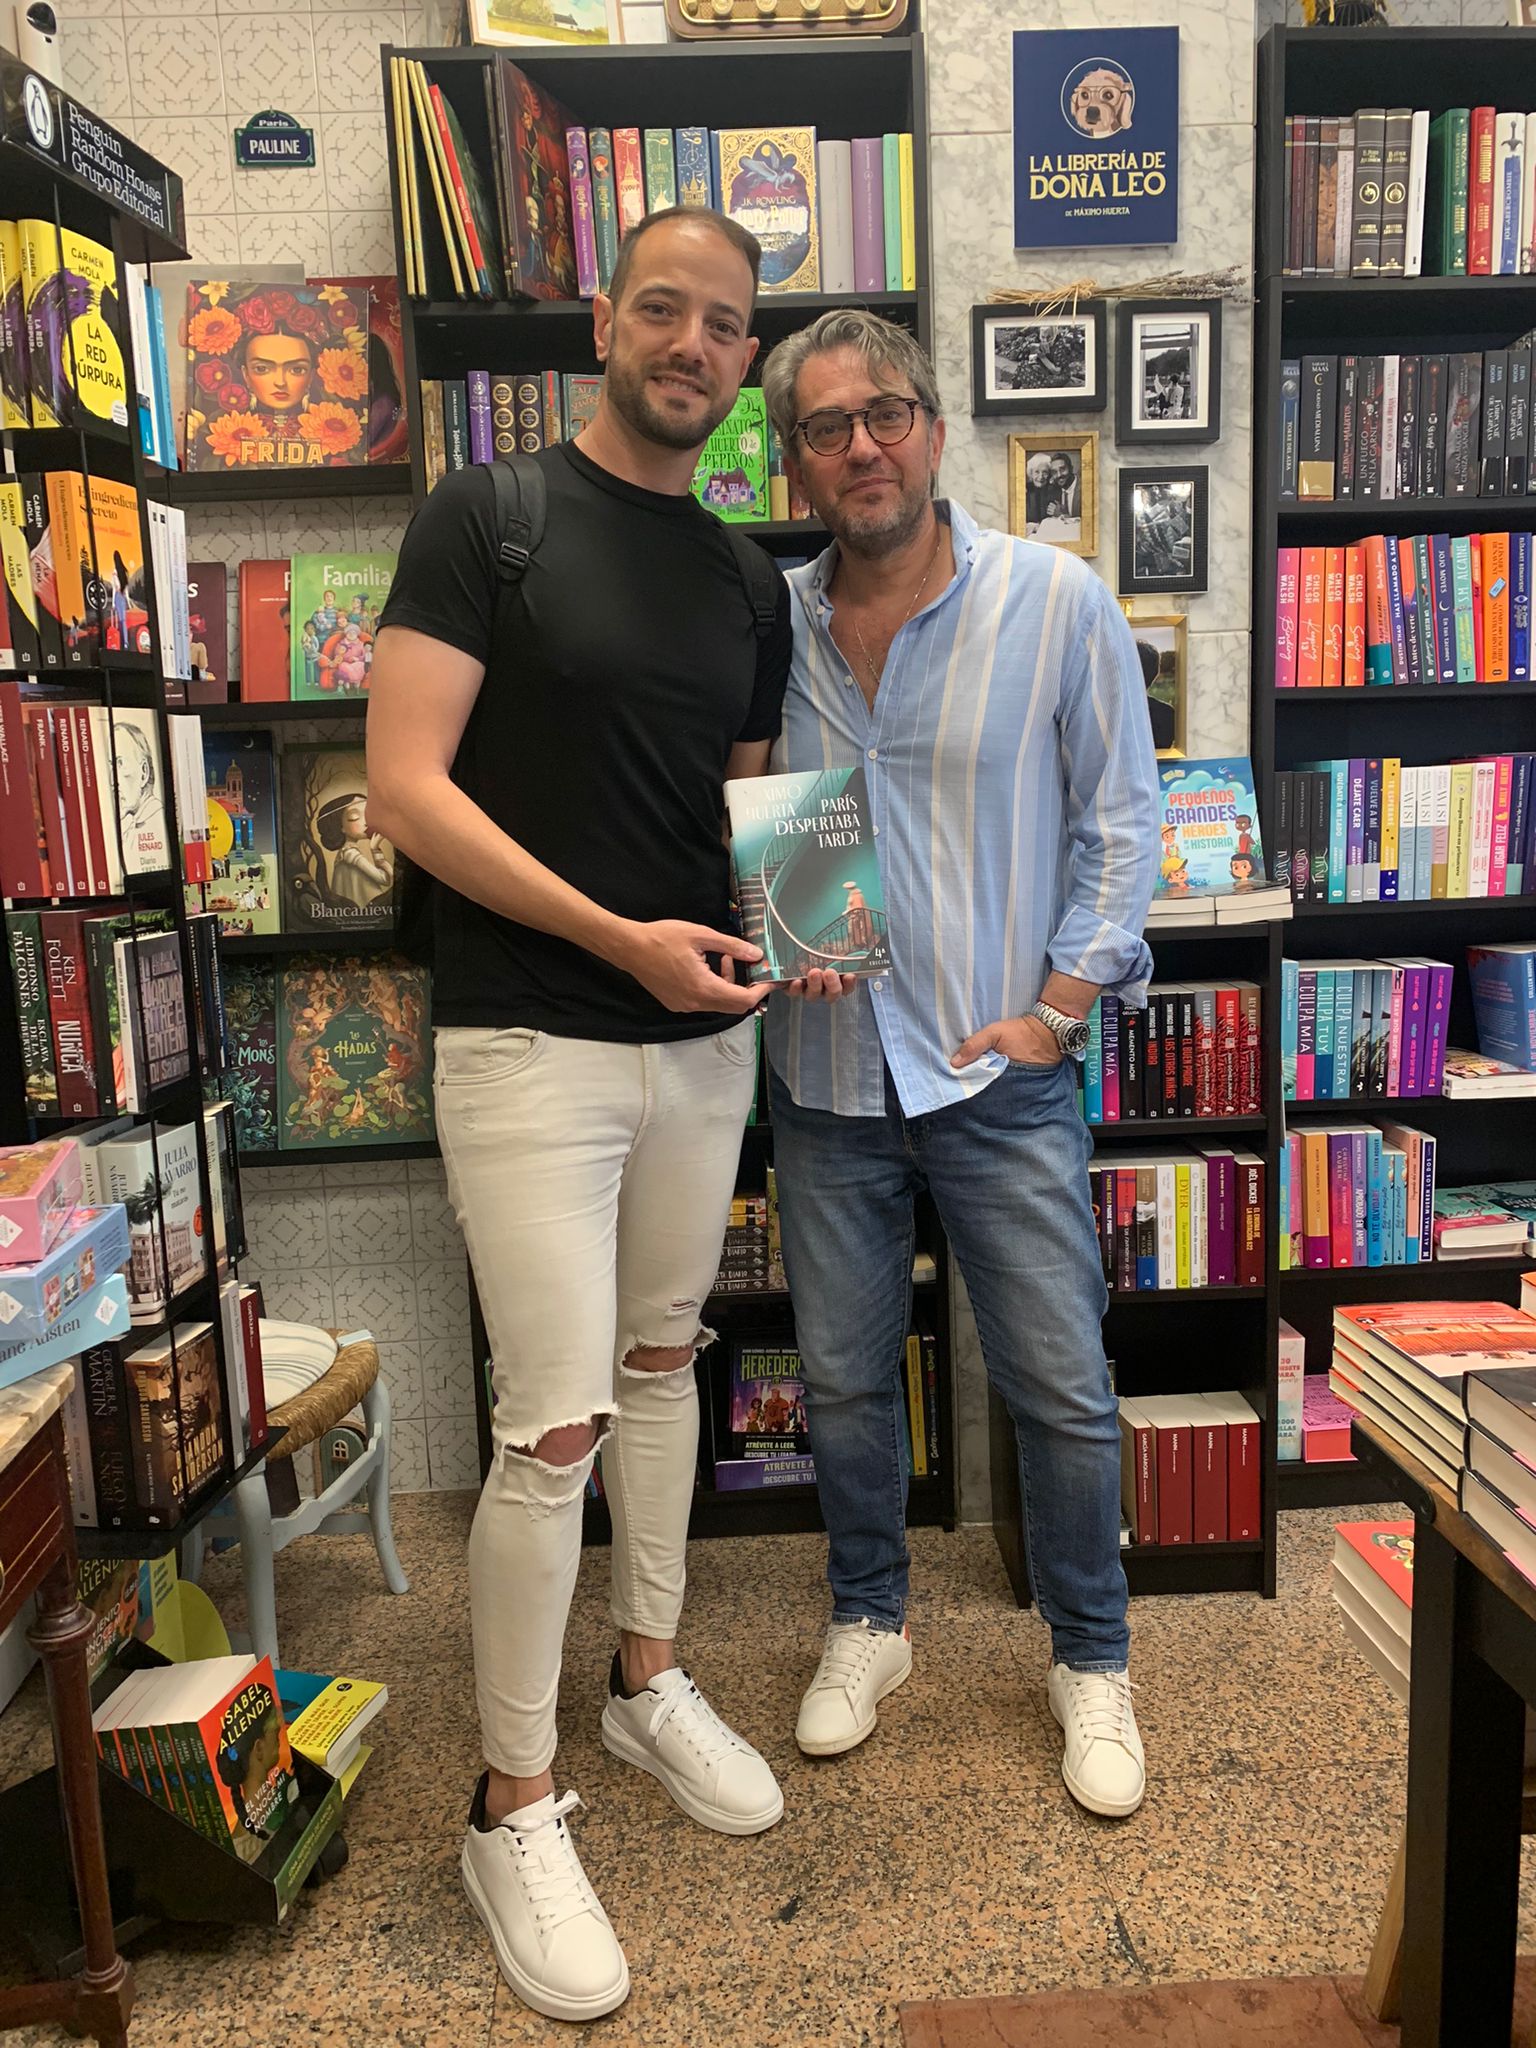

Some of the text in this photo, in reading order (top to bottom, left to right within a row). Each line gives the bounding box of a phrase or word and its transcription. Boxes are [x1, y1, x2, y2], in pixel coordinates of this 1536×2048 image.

[67, 101, 123, 158] Penguin
[259, 119, 289, 127] Paris
[249, 139, 301, 154] PAULINE
[1030, 150, 1166, 172] LA LIBRERÍA DE
[71, 126, 161, 205] Random House
[72, 152, 164, 228] Grupo Editorial
[1030, 171, 1166, 199] DOÑA LEO
[1505, 171, 1513, 225] ABERCROMBIE
[1074, 207, 1102, 217] MÁXIMO
[1103, 207, 1130, 215] HUERTA
[71, 248, 104, 269] CARMEN
[78, 265, 100, 280] MOLA
[87, 323, 102, 341] LA
[86, 344, 107, 364] RED
[78, 358, 123, 391] ÚRPURA
[241, 442, 324, 463] FRIDA
[704, 453, 754, 468] PEPINOS
[1360, 431, 1369, 479] UN FUEGO
[1369, 426, 1377, 484] EN LA CARNE
[7, 493, 16, 526] CARMEN
[33, 494, 41, 528] CARMEN
[8, 556, 17, 587] MADRES
[15, 564, 23, 578] LAS
[324, 564, 391, 587] Familia
[1392, 564, 1400, 601] LLAMADO
[1280, 575, 1288, 604] WALSH
[1279, 616, 1294, 661] Binding
[1410, 634, 1417, 643] de
[36, 718, 46, 747] FRANK
[59, 718, 69, 753] RENARD
[79, 718, 89, 753] RENARD
[1169, 788, 1235, 807] PEQUEÑOS
[1370, 779, 1378, 806] VUELVE
[1499, 763, 1509, 808] EMILY HENRY
[821, 794, 858, 813] PARÍS
[1165, 805, 1237, 824] GRANDES
[1353, 778, 1361, 828] DÉJATE CAER
[775, 813, 861, 836] DESPERTABA
[1369, 815, 1378, 828] MÍ
[138, 833, 155, 842] JULES
[138, 841, 162, 852] RENARD
[816, 830, 862, 849] TARDE
[1190, 837, 1233, 849] HISTORIA
[1494, 824, 1507, 869] LUGAR FELIZ
[140, 857, 156, 865] Diario
[13, 931, 31, 1008] FALCONES
[25, 937, 39, 1001] ILDEFONSO
[47, 939, 66, 1001] FOLLETT
[63, 955, 77, 985] KEN
[1248, 997, 1256, 1031] REY BLANCO
[1299, 986, 1315, 1053] CULPA MÍA
[1317, 986, 1334, 1055] CULPA TUY
[20, 1015, 33, 1067] LIBERTAD
[37, 1019, 48, 1063] ESCLAVA
[57, 1020, 83, 1074] NUNCA
[334, 1040, 377, 1058] HADAS
[1104, 1016, 1118, 1077] CULPA MÍA
[1128, 1029, 1136, 1063] MEMENTO
[1336, 986, 1352, 1085] CULPA NUESTRA
[1148, 1041, 1158, 1065] INDIRA
[1182, 1038, 1192, 1087] EL BUEN PADRE
[1088, 1054, 1098, 1086] TUYA
[1165, 1038, 1175, 1099] LAS OTRAS NIÑAS
[165, 1145, 189, 1169] JULIA
[118, 1168, 128, 1198] JULIA
[1180, 1179, 1188, 1209] DYER
[1249, 1168, 1257, 1205] JOËL DICKER
[1357, 1220, 1364, 1229] EN
[1357, 1229, 1365, 1247] AMOR
[1372, 1223, 1379, 1231] TE
[1372, 1233, 1379, 1242] NO
[1424, 1237, 1429, 1246] AL
[88, 1349, 107, 1416] MARTIN
[745, 1441, 773, 1449] ATRÉVETE
[764, 1460, 806, 1471] ATRÉVETE
[802, 1473, 812, 1481] TU
[220, 1682, 262, 1730] ISABEL
[219, 1690, 272, 1755] ALLENDE
[245, 1766, 280, 1813] EL VIENTO
[245, 1773, 286, 1829] CONOCE MI
[253, 1791, 283, 1833] NOMBRE
